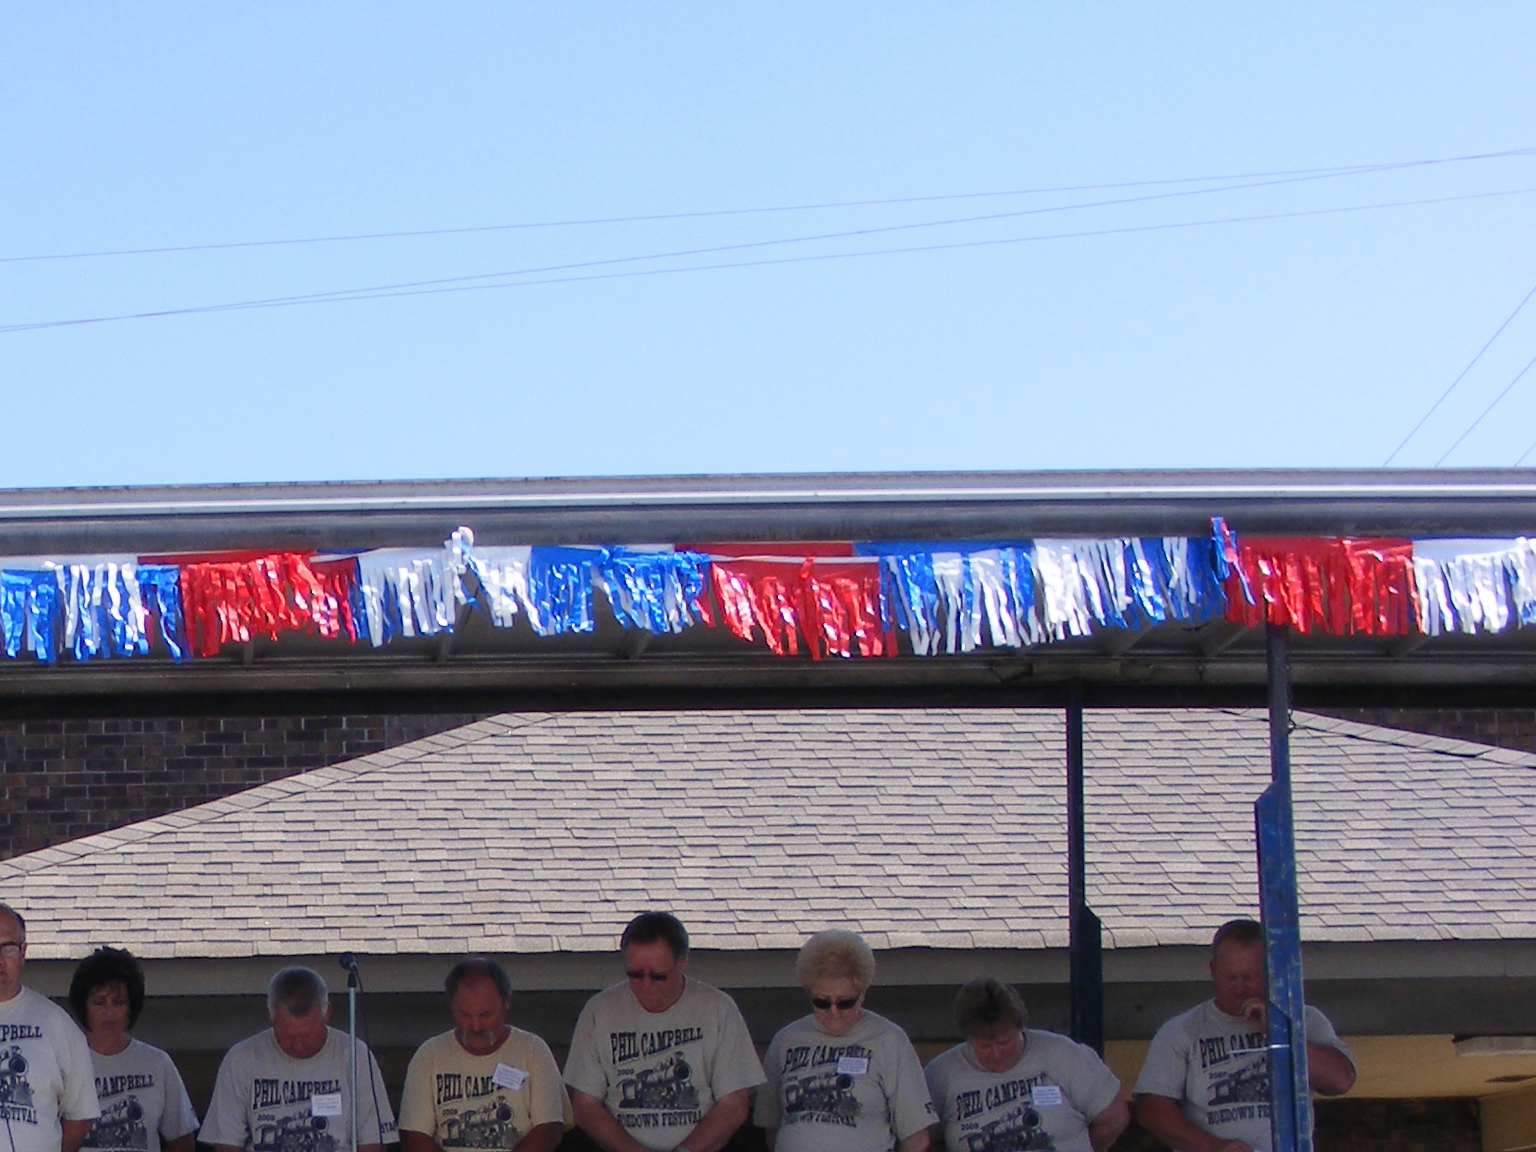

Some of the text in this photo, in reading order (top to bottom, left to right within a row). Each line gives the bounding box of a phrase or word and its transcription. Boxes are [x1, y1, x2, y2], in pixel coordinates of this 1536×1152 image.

[610, 1027, 703, 1064] PHIL CAMPBELL
[1199, 1036, 1230, 1068] PHIL
[253, 1079, 281, 1109] PHIL
[282, 1079, 341, 1104] CAMPBELL
[436, 1073, 463, 1105] PHIL
[956, 1090, 983, 1121] PHIL
